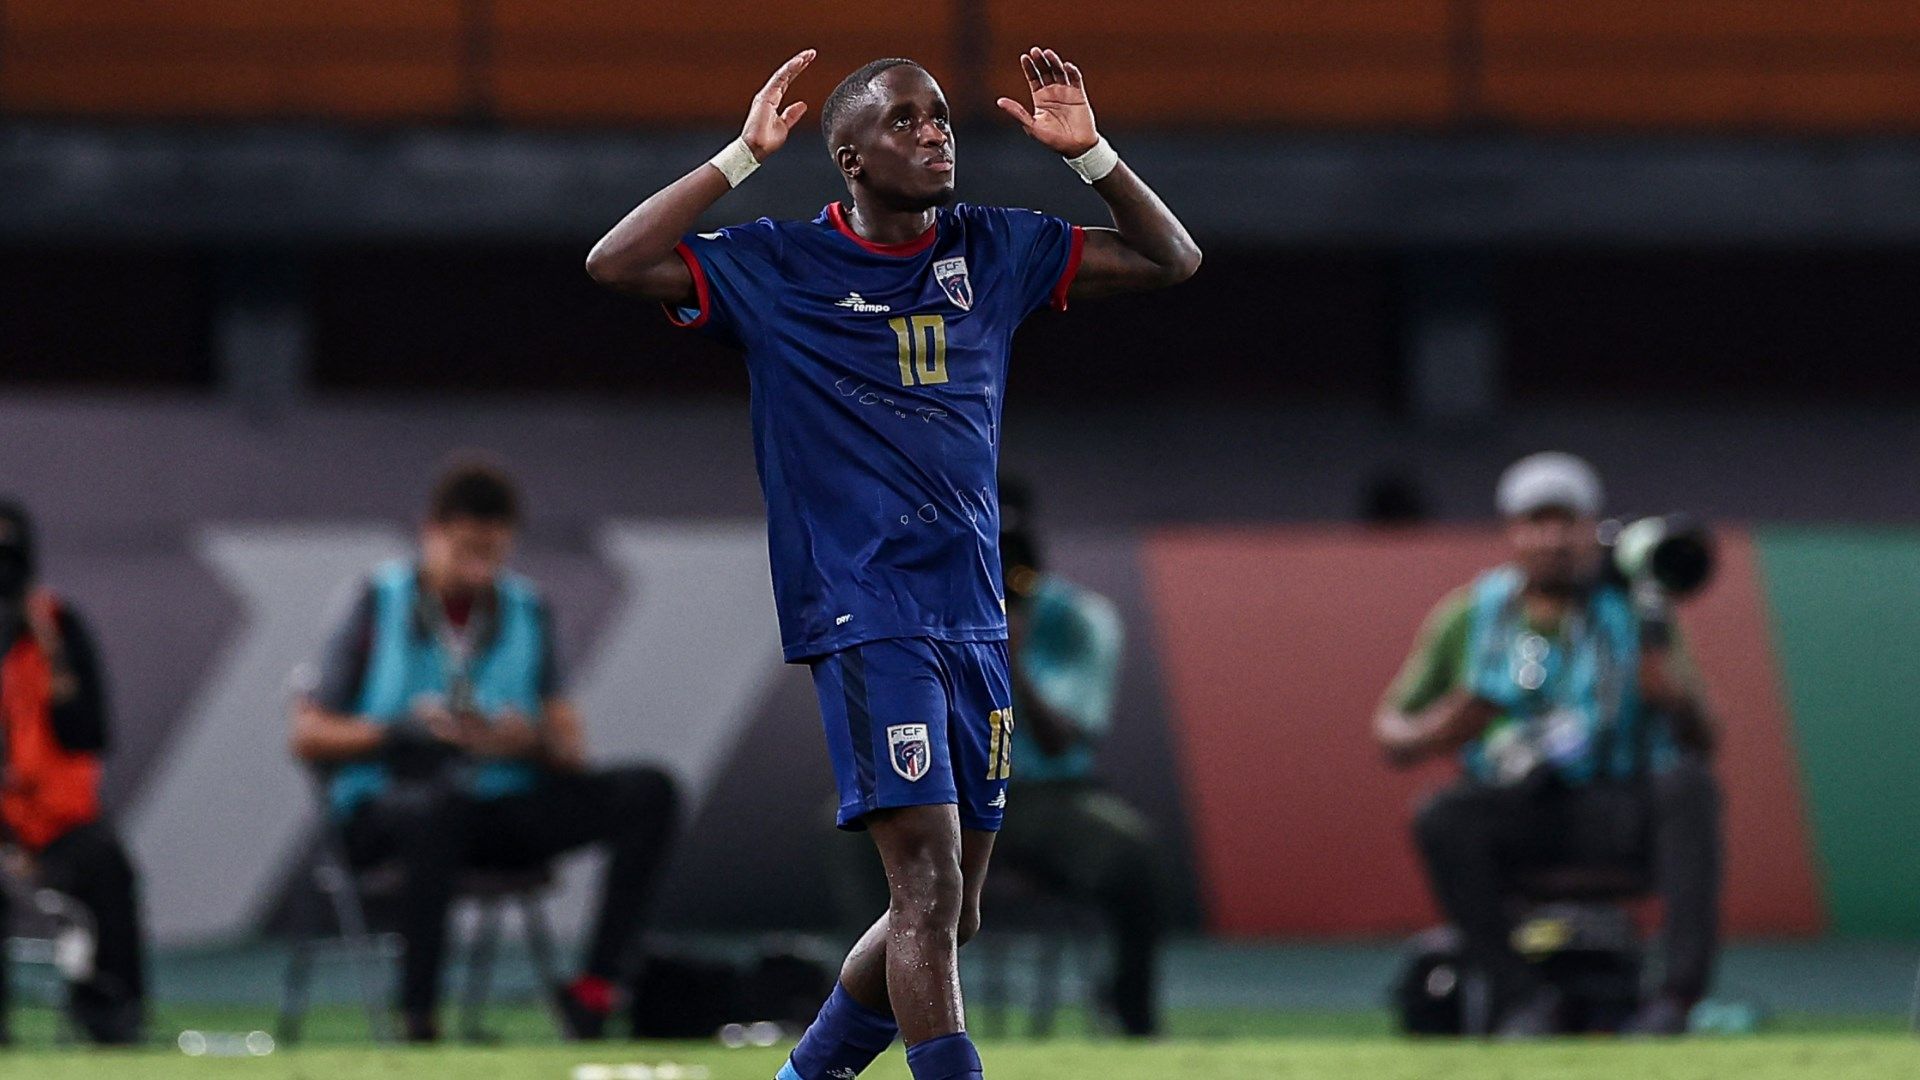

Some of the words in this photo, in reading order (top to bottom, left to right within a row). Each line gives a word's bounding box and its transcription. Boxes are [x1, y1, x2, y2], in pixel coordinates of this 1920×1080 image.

[936, 260, 961, 274] FCF
[853, 303, 890, 313] tempo
[888, 315, 949, 387] 10
[891, 727, 923, 738] FCF
[986, 706, 1014, 780] 10
